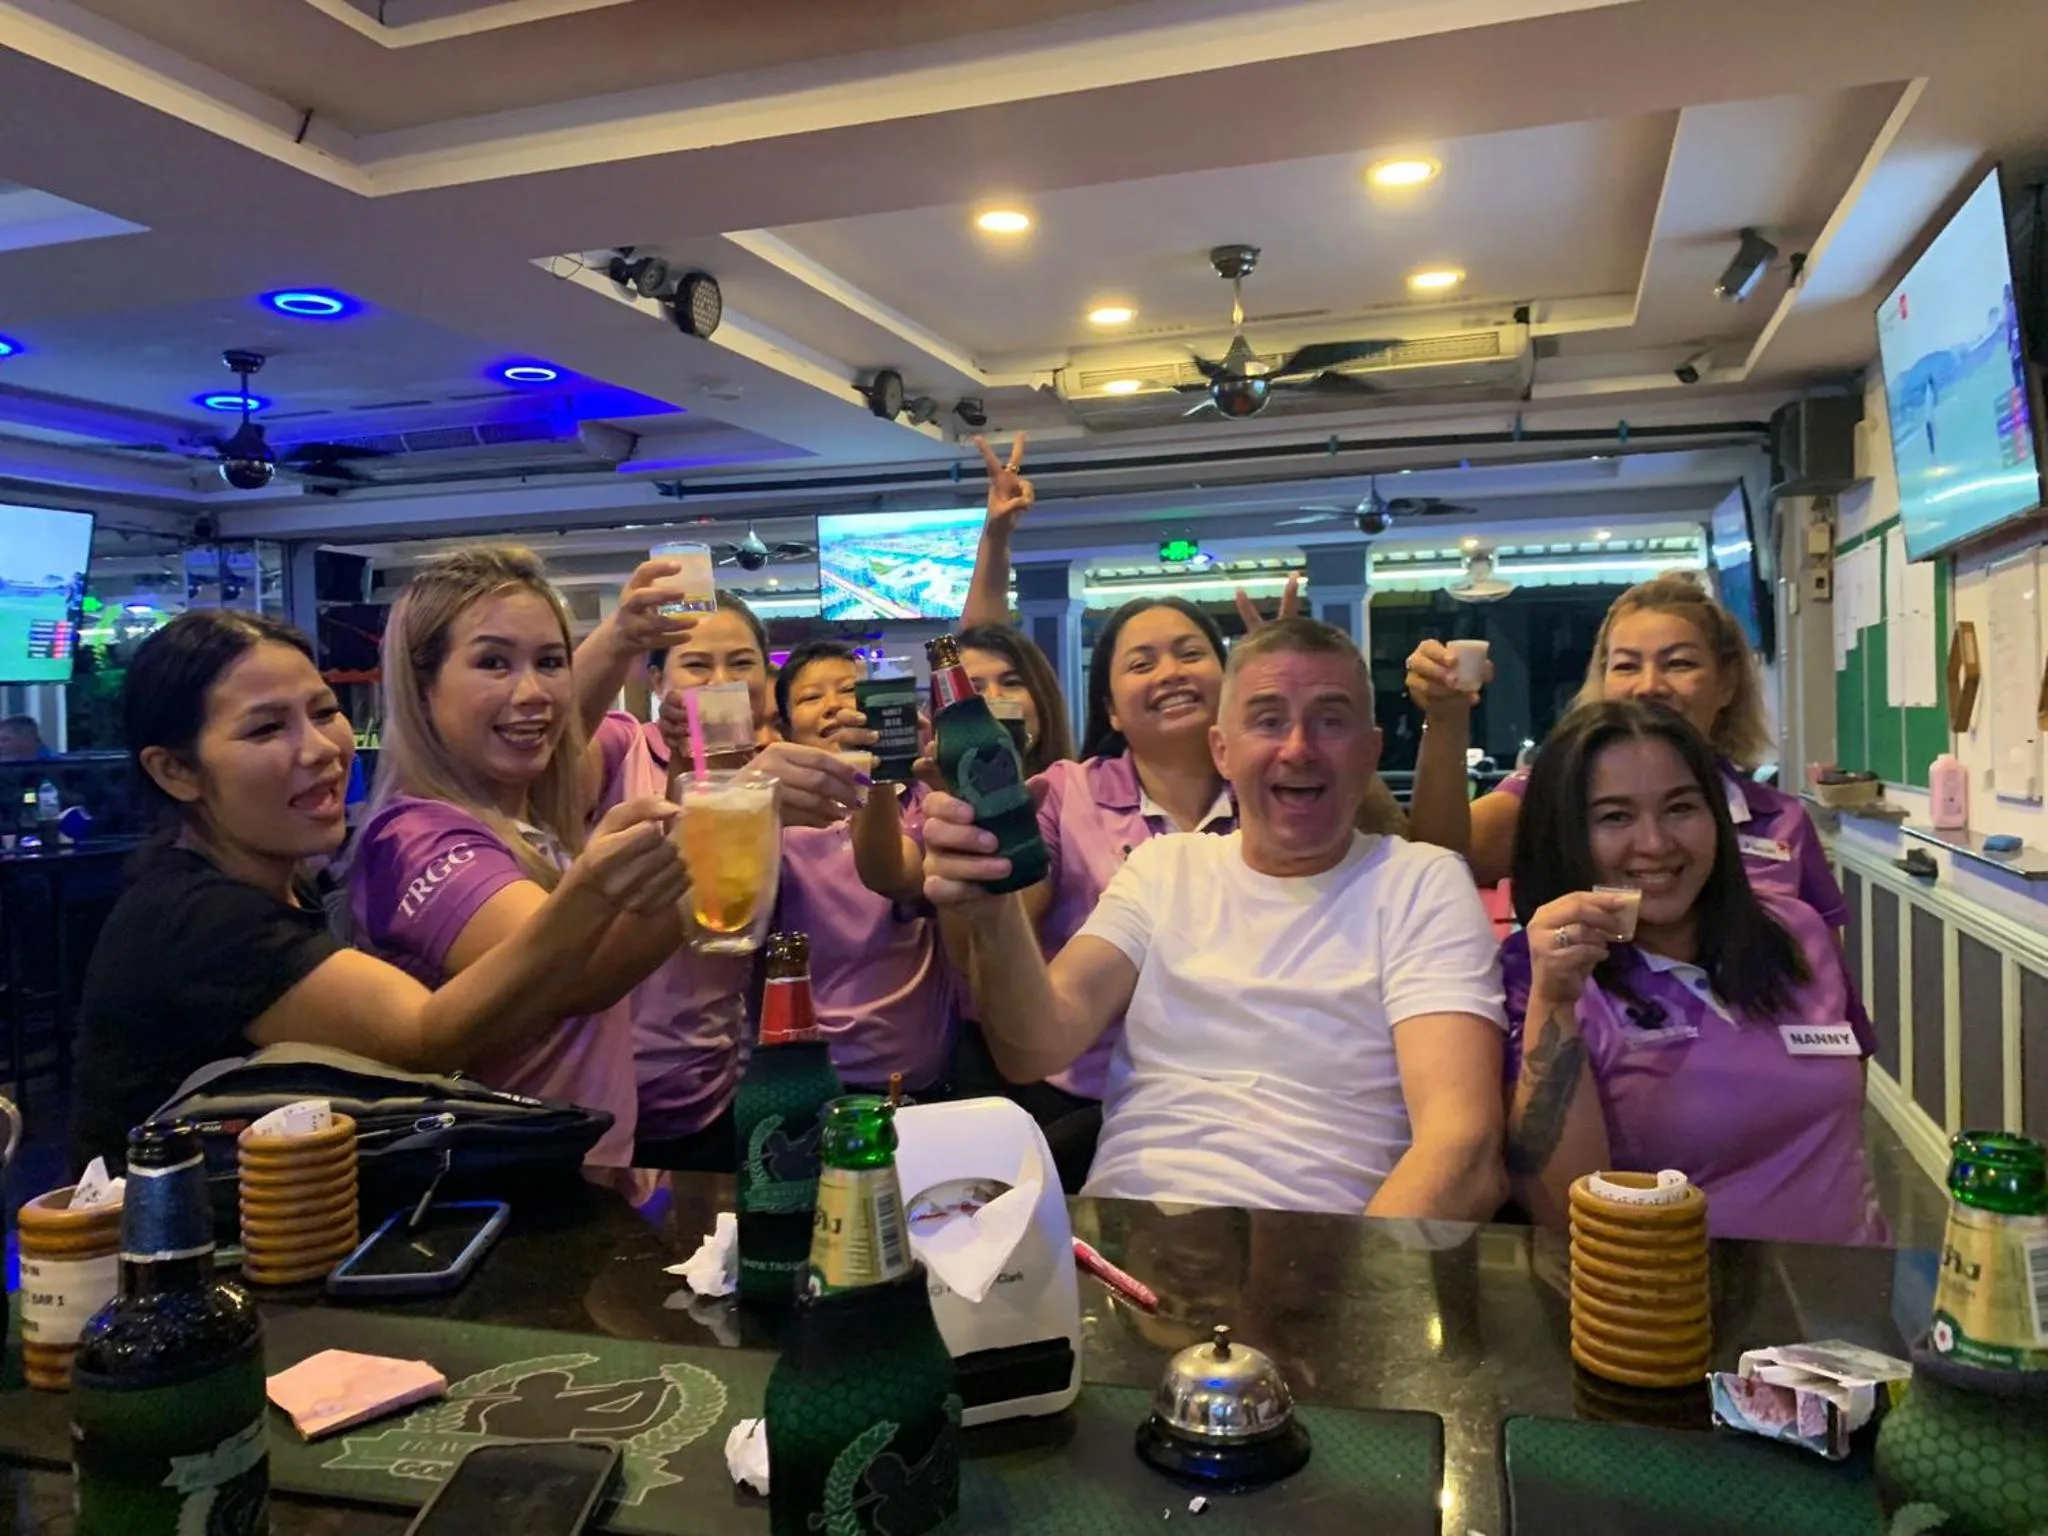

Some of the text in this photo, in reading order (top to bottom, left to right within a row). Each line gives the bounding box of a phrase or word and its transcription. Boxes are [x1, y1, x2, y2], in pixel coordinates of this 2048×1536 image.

[398, 842, 475, 917] TRGG
[1790, 1032, 1850, 1045] NANNY
[57, 1295, 65, 1308] 1
